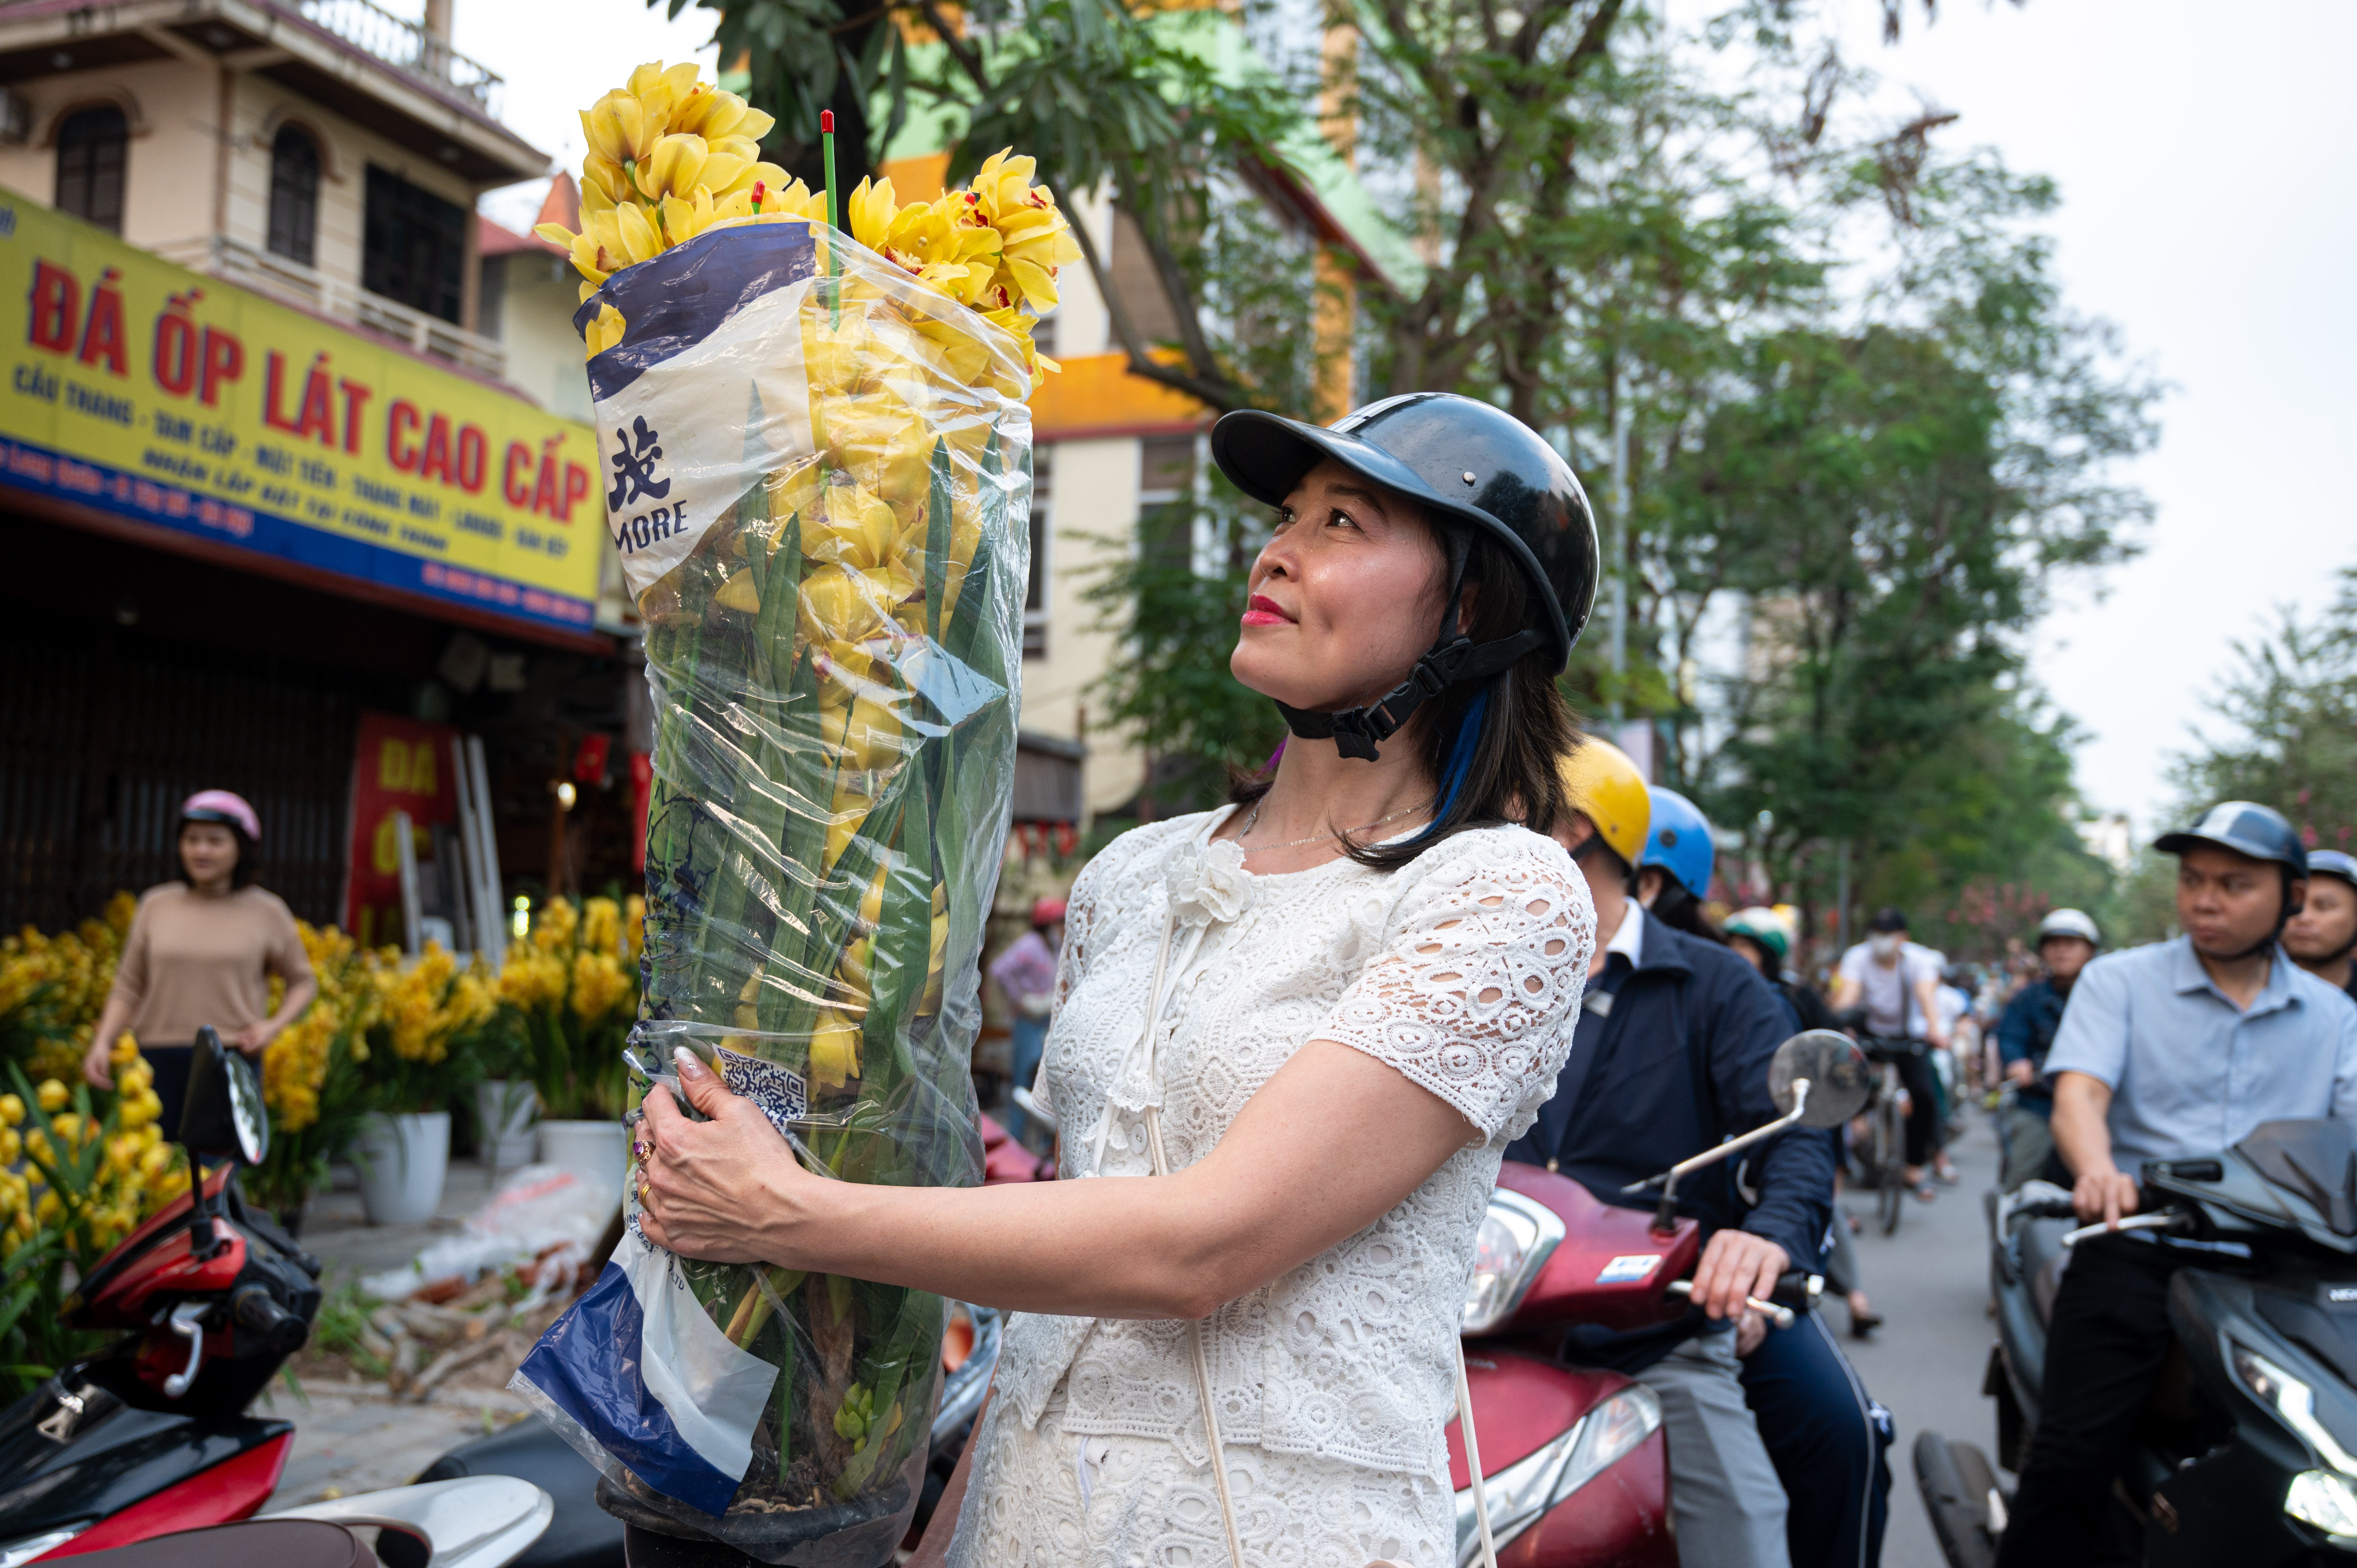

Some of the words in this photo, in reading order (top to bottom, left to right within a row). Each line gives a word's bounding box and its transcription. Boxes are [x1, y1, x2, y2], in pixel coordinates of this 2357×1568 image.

[30, 258, 127, 378] ĐÁ
[154, 289, 244, 407] ỐP
[264, 350, 370, 455] LÁT
[387, 399, 487, 493] CAO
[505, 433, 590, 524] CẤP
